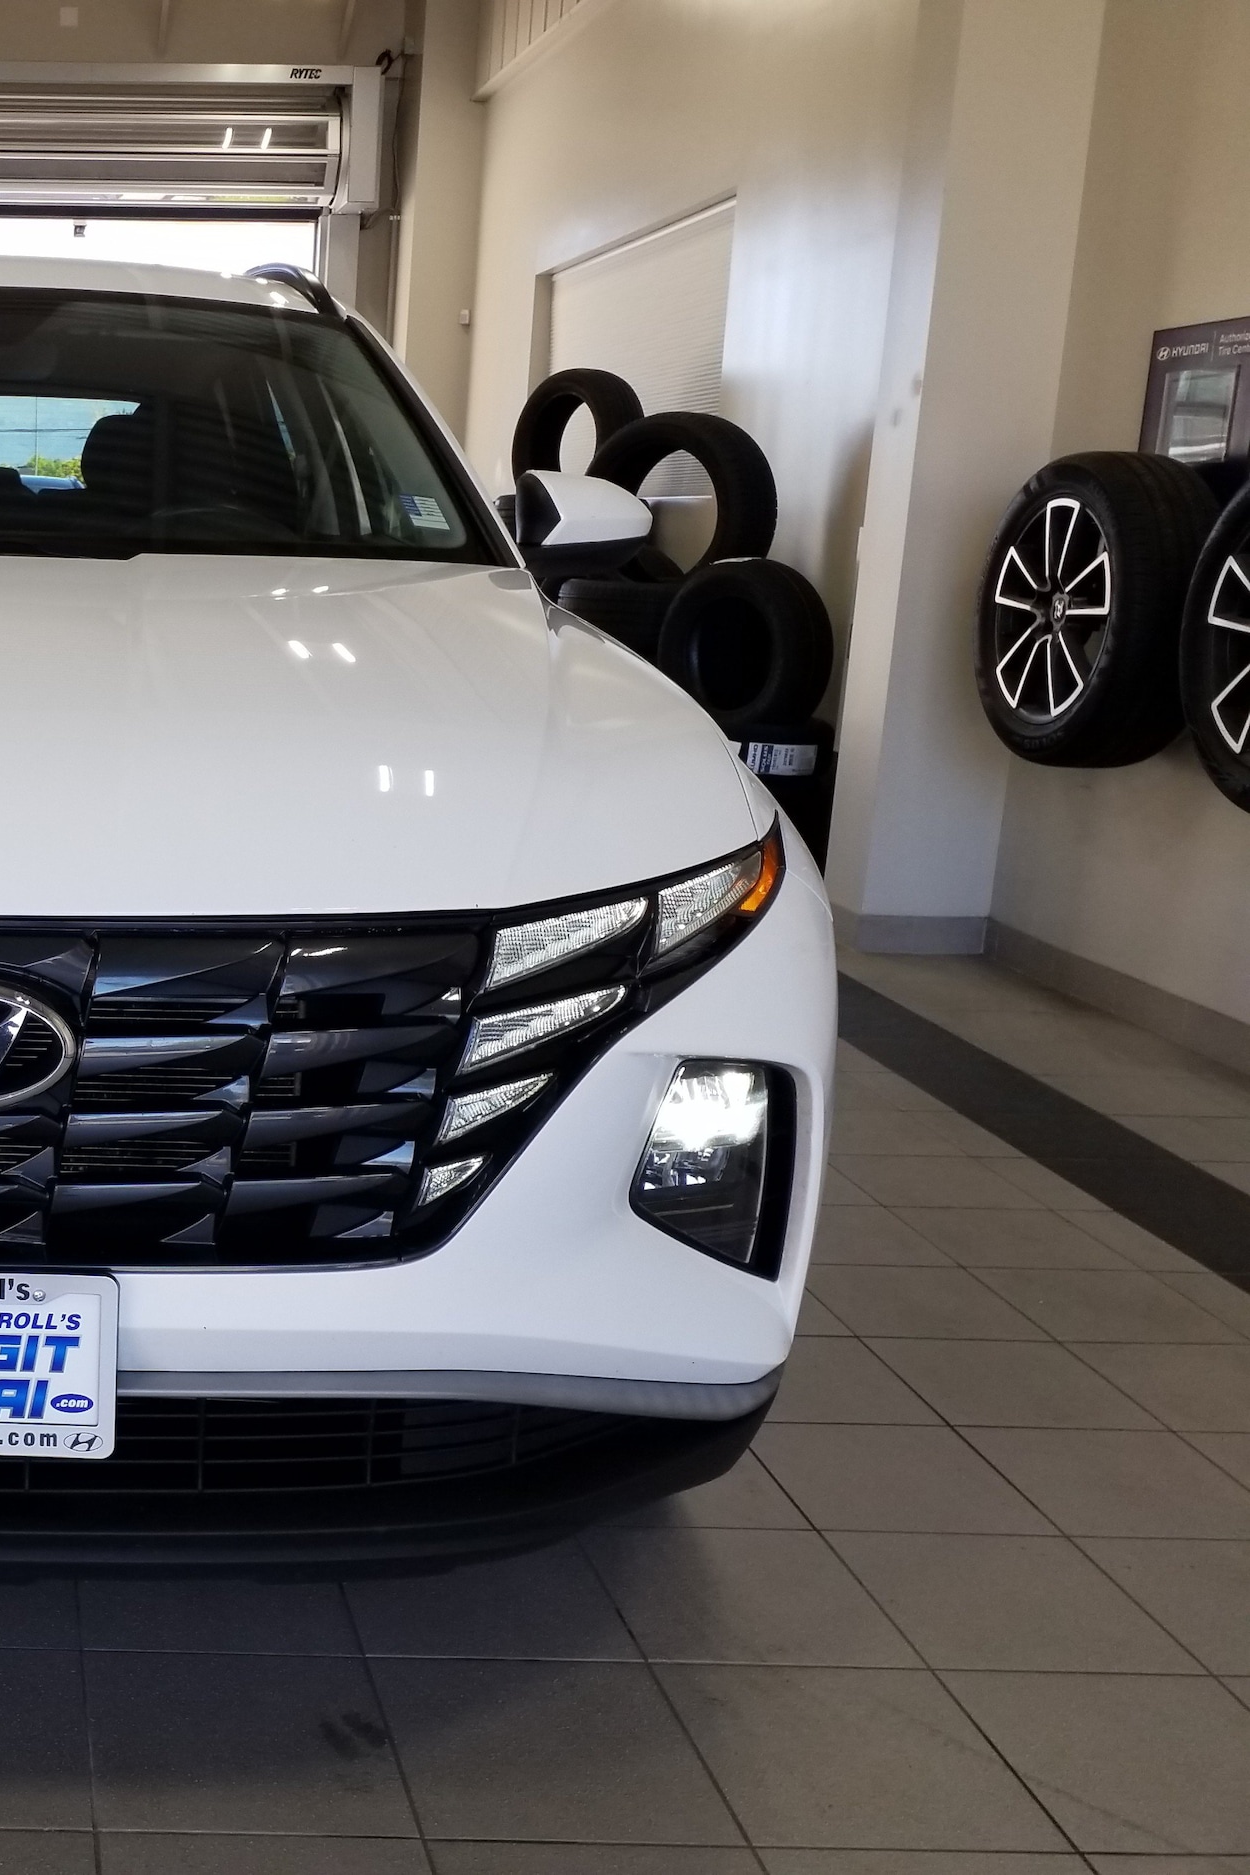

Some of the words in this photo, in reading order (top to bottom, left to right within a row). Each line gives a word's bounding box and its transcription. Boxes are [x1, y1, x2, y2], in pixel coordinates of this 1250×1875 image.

[289, 68, 322, 79] RYTEC
[1219, 331, 1250, 343] Authoriz
[1171, 342, 1209, 357] HYUNDAI
[54, 1396, 89, 1410] .com
